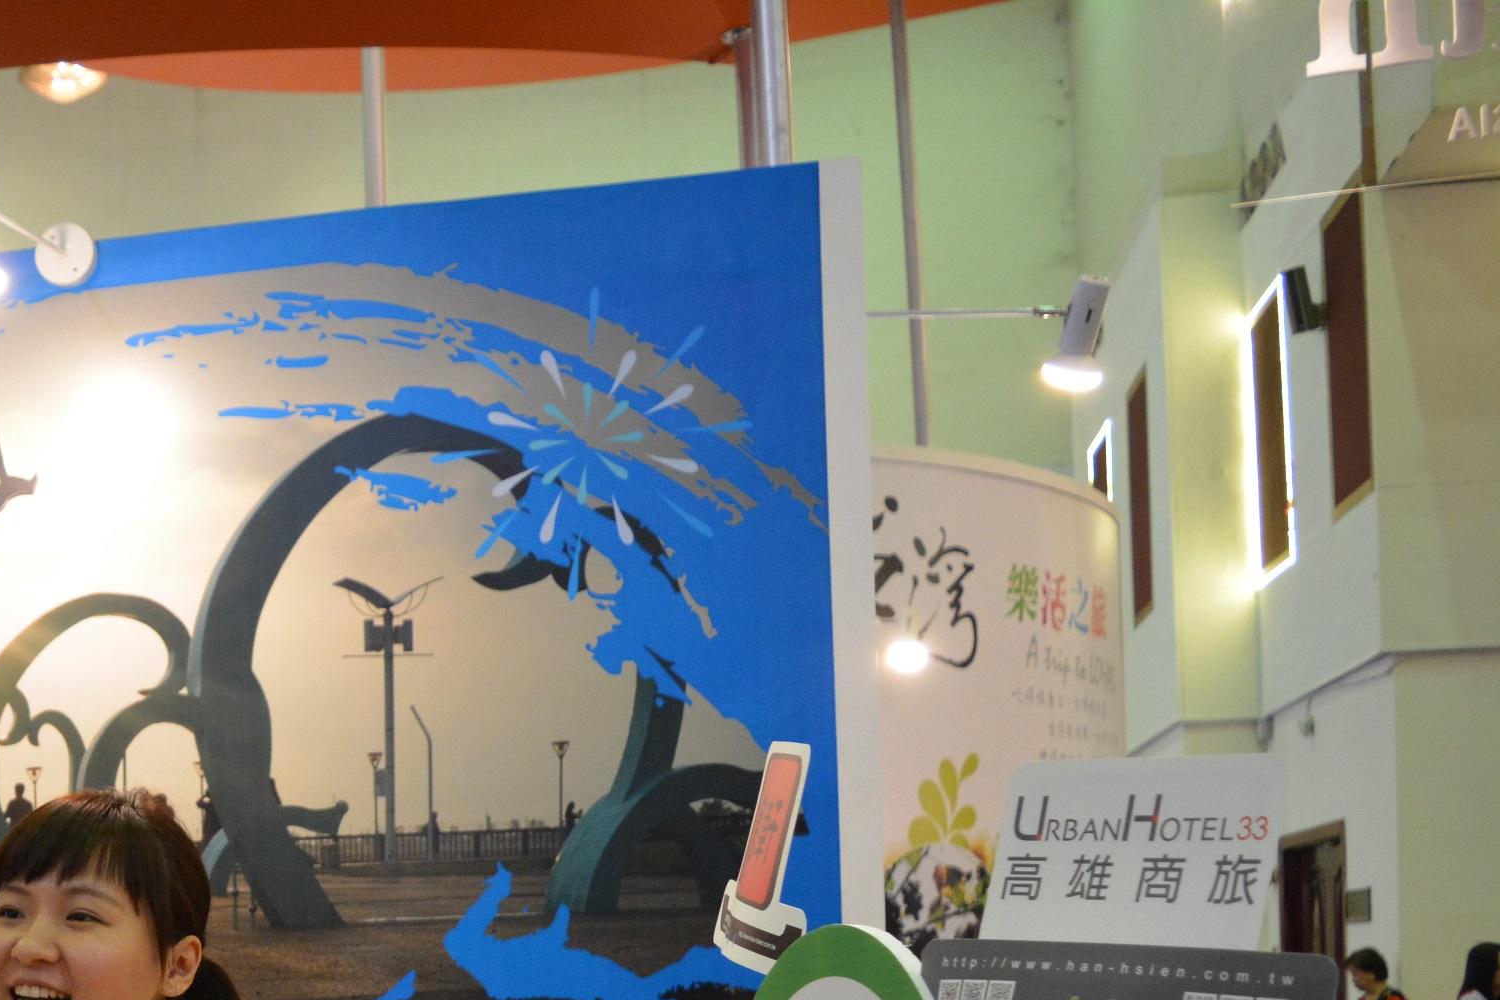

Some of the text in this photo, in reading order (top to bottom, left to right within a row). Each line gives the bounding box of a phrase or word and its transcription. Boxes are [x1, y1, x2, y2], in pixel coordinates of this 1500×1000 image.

[1000, 853, 1262, 905] 高雄商旅
[941, 955, 1296, 987] http://www.han-hsien.com.tw
